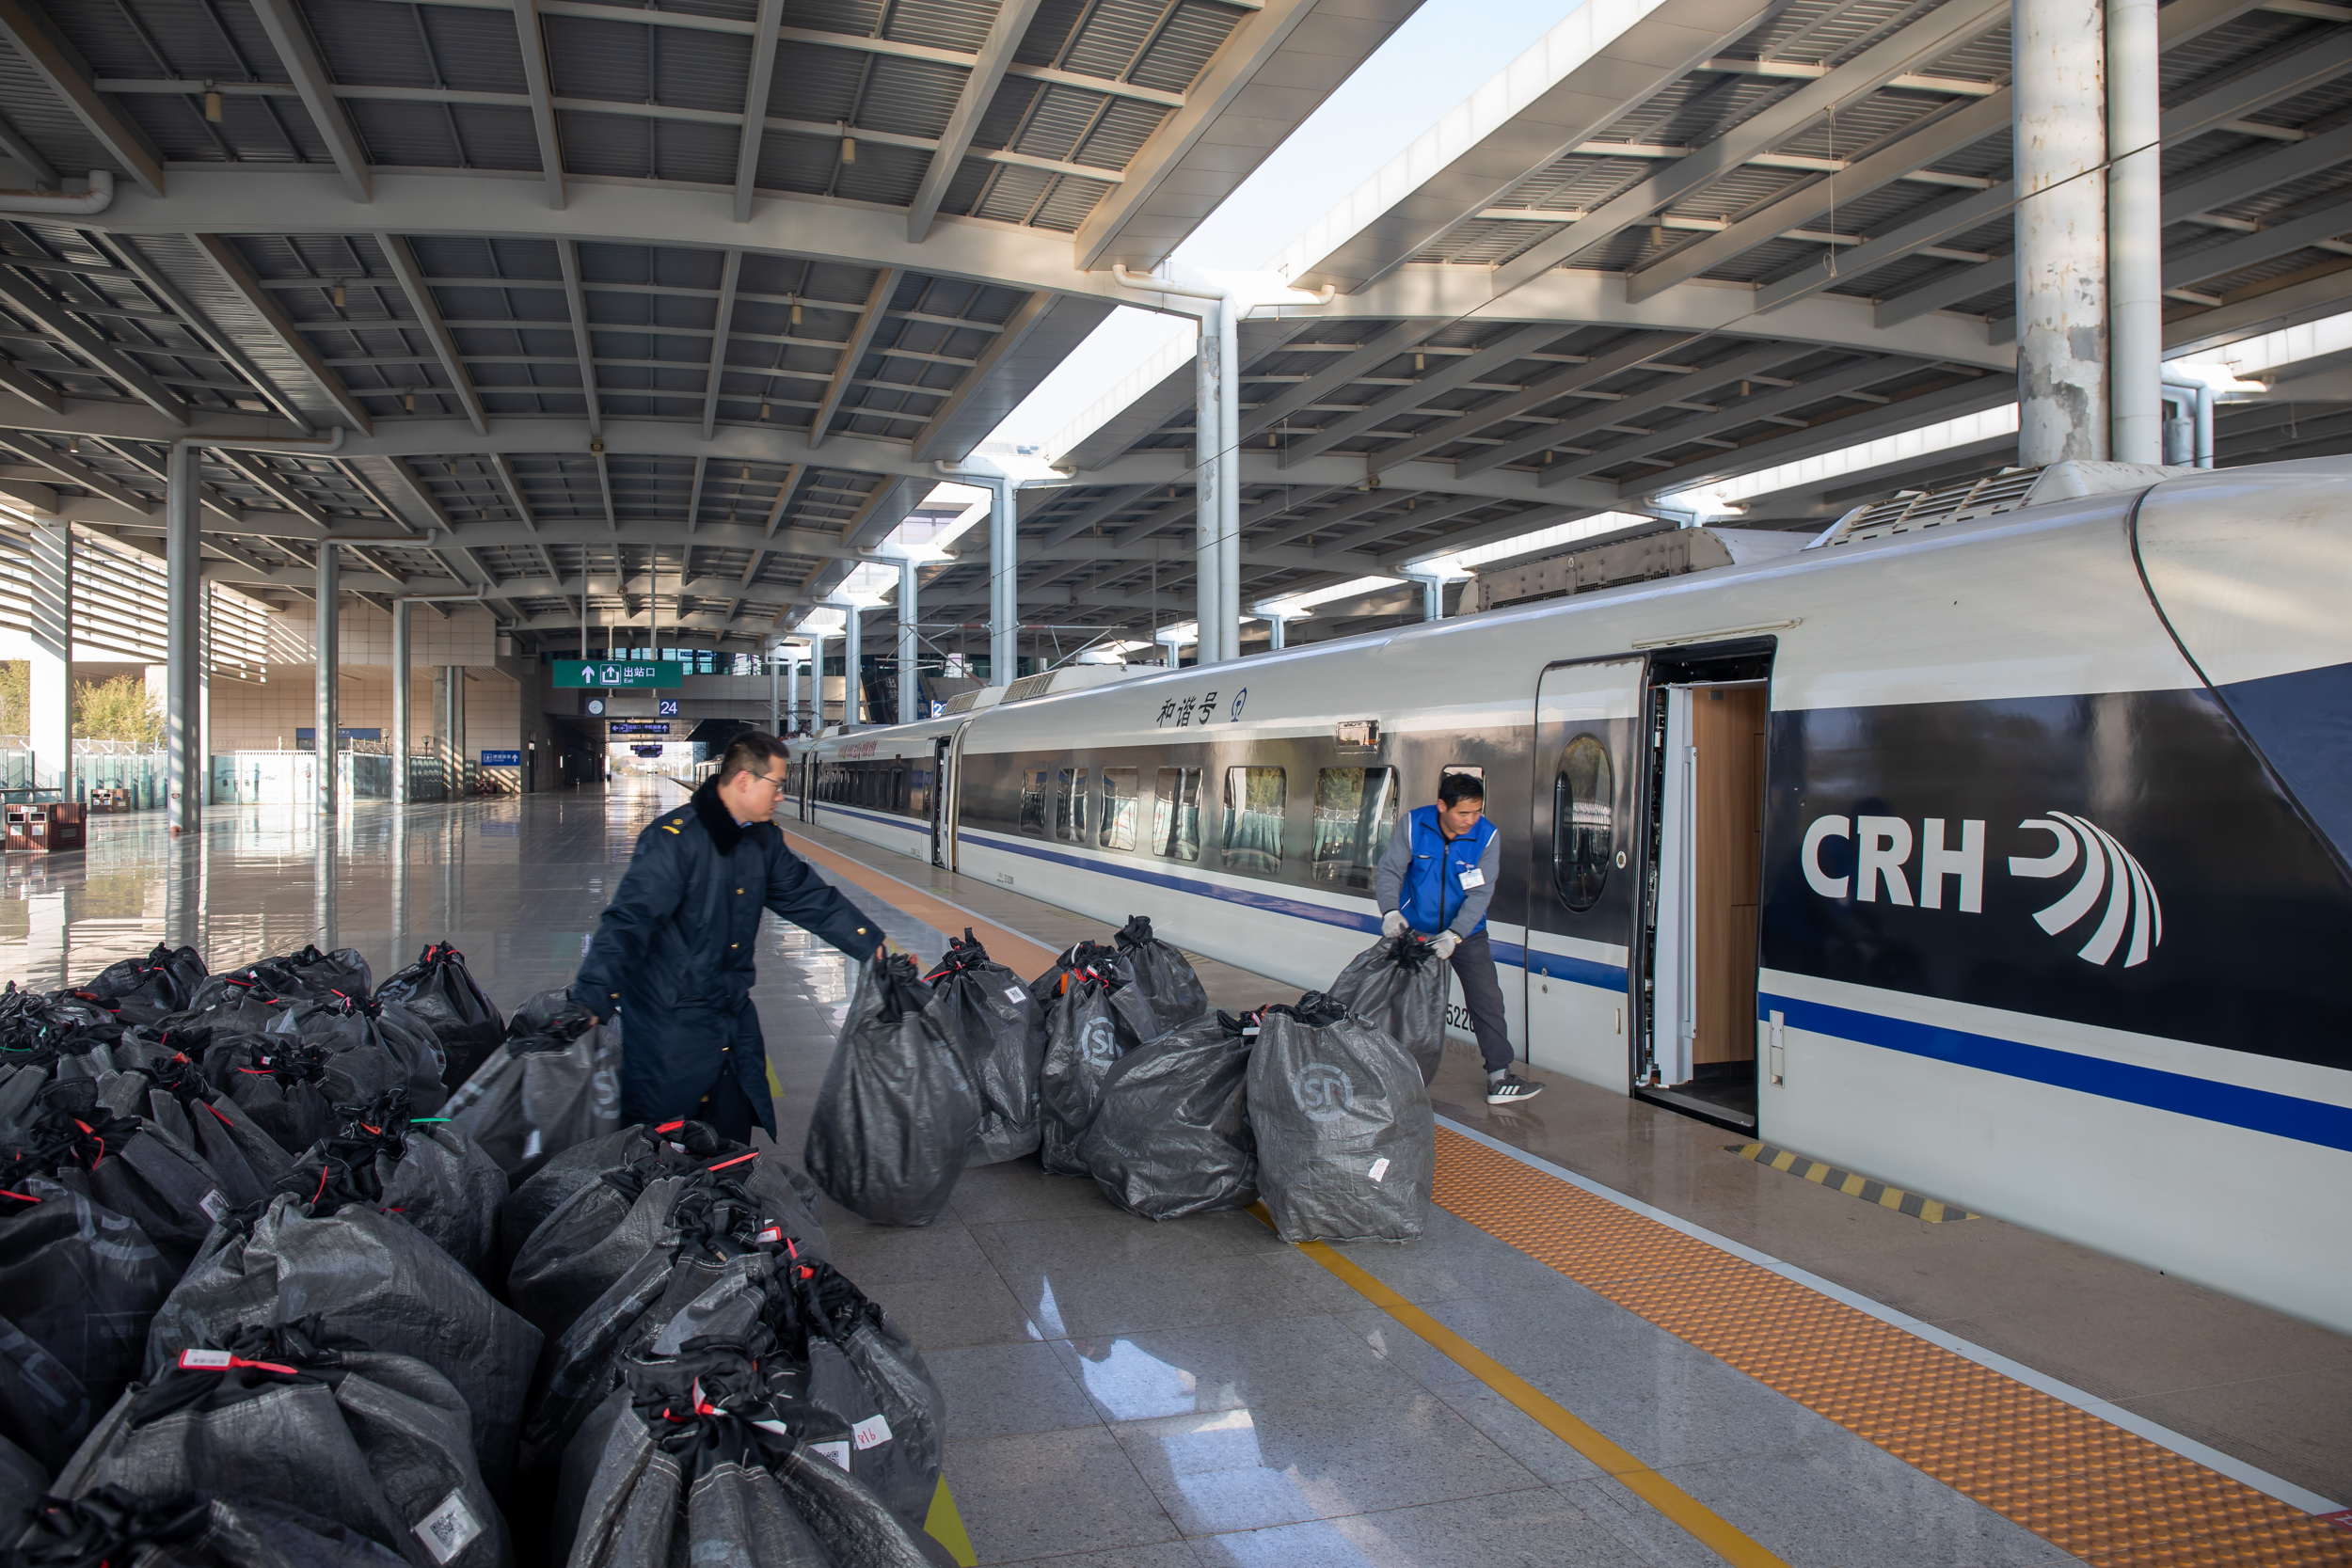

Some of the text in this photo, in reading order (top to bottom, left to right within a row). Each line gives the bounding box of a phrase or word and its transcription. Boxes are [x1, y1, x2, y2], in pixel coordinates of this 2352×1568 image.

[624, 666, 655, 677] 出站口
[660, 701, 677, 714] 24
[1156, 691, 1217, 728] 和谐号
[1802, 815, 1985, 913] CRH
